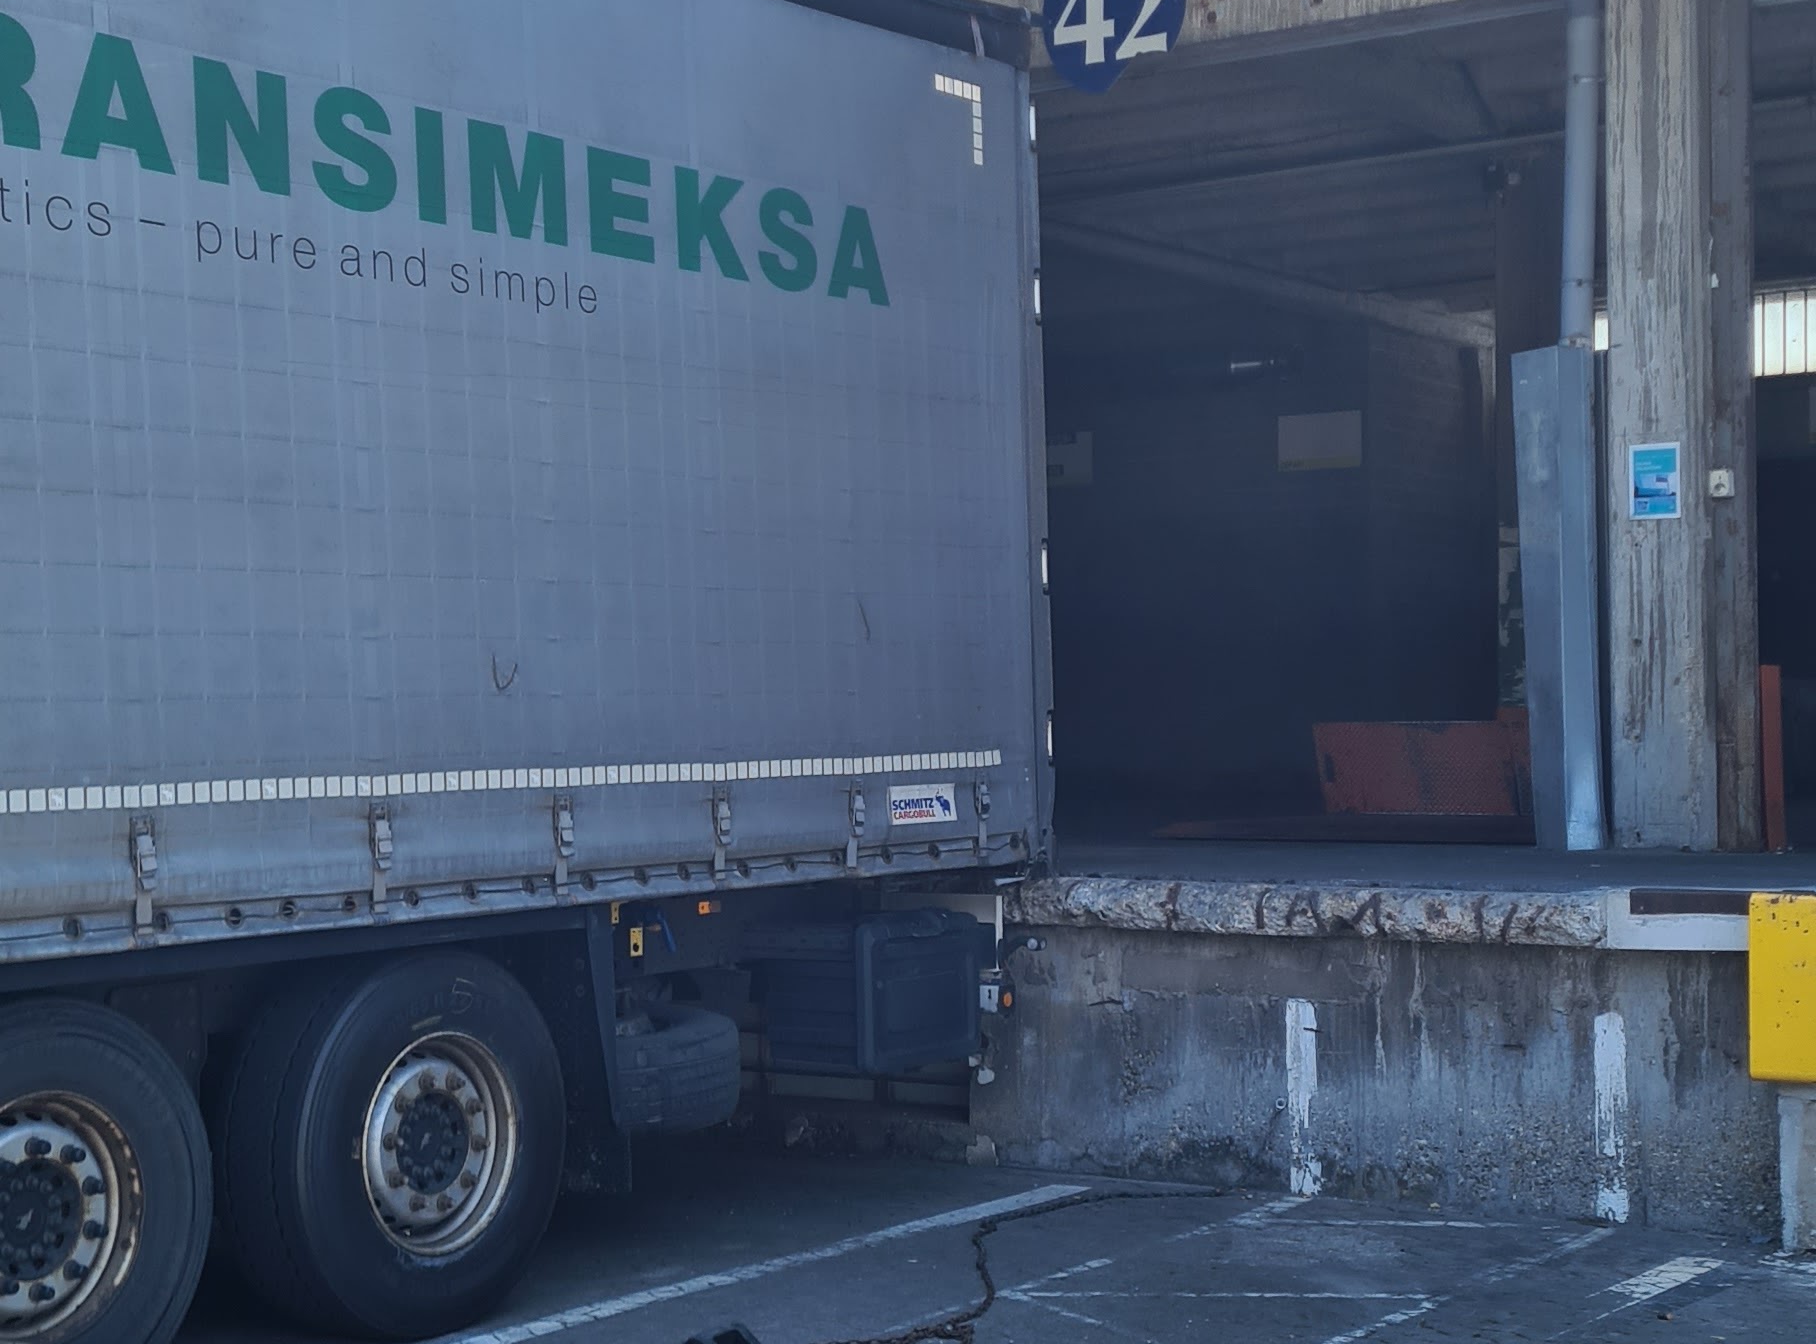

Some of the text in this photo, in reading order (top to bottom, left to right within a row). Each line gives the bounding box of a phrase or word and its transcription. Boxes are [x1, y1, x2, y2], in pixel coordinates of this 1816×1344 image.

[196, 219, 316, 270] pure
[340, 244, 427, 288] and
[450, 257, 598, 313] simple
[892, 797, 935, 811] SCHMITZ
[893, 809, 936, 820] CARGOBULL
